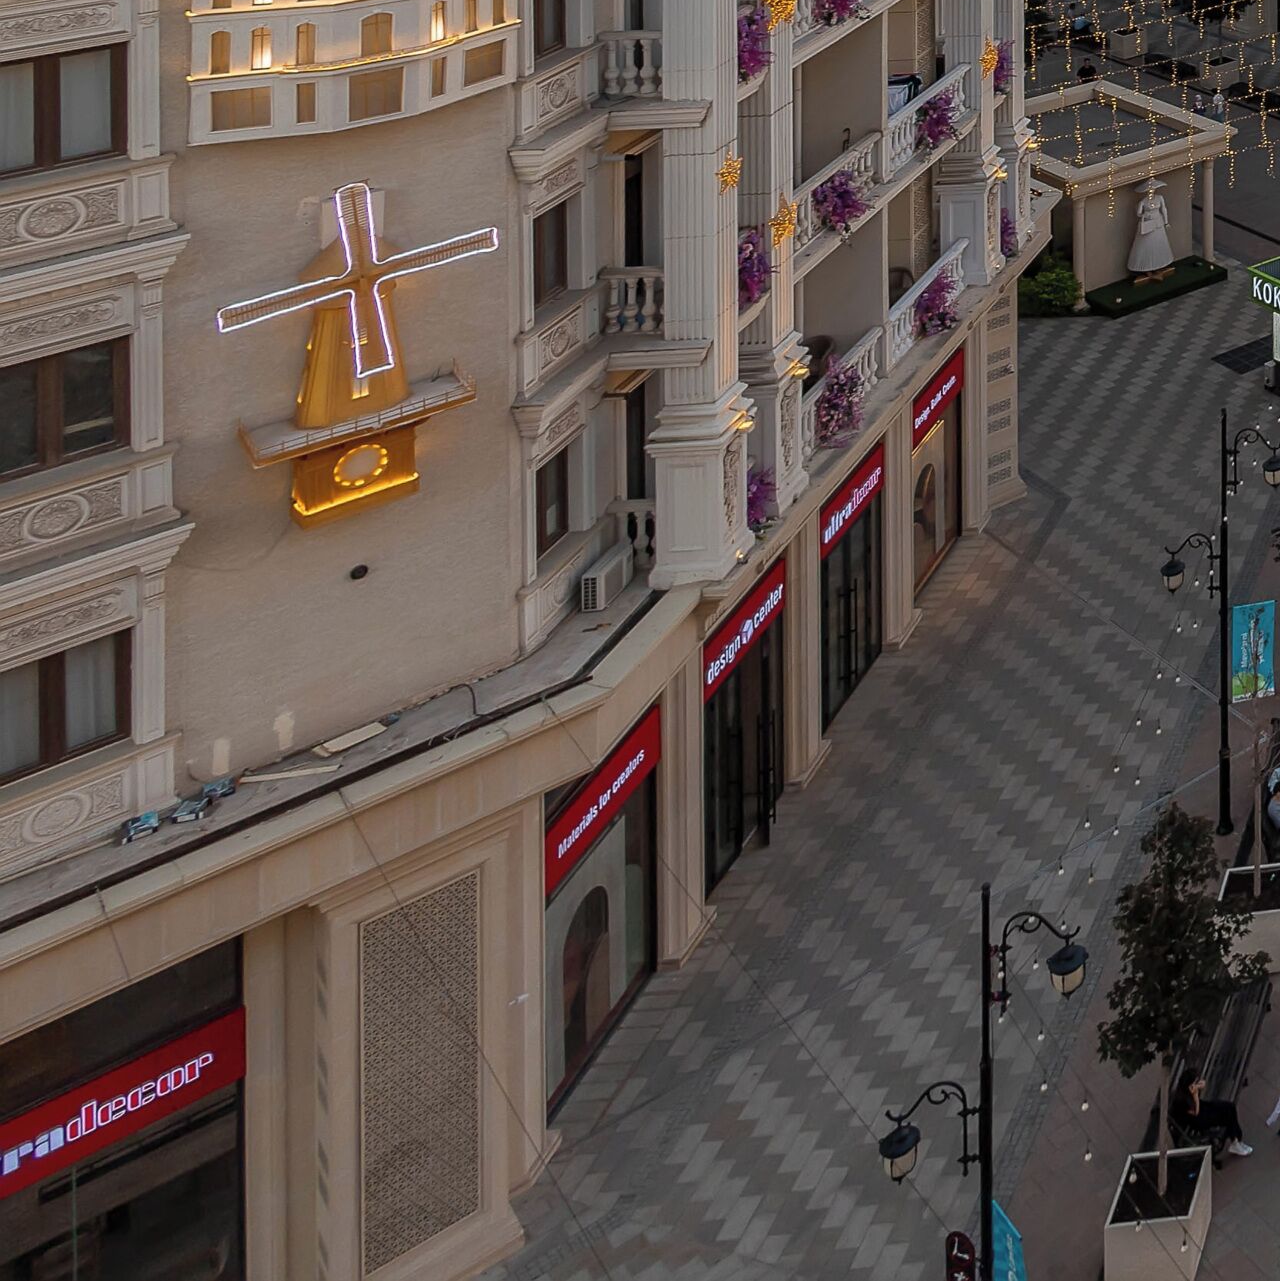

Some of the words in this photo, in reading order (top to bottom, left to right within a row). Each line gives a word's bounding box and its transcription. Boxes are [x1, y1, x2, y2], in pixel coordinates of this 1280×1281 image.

[707, 635, 741, 685] design
[753, 583, 784, 629] center
[558, 805, 599, 859] Materials
[599, 789, 612, 810] for
[612, 749, 645, 794] creators
[0, 1052, 214, 1176] radecor
